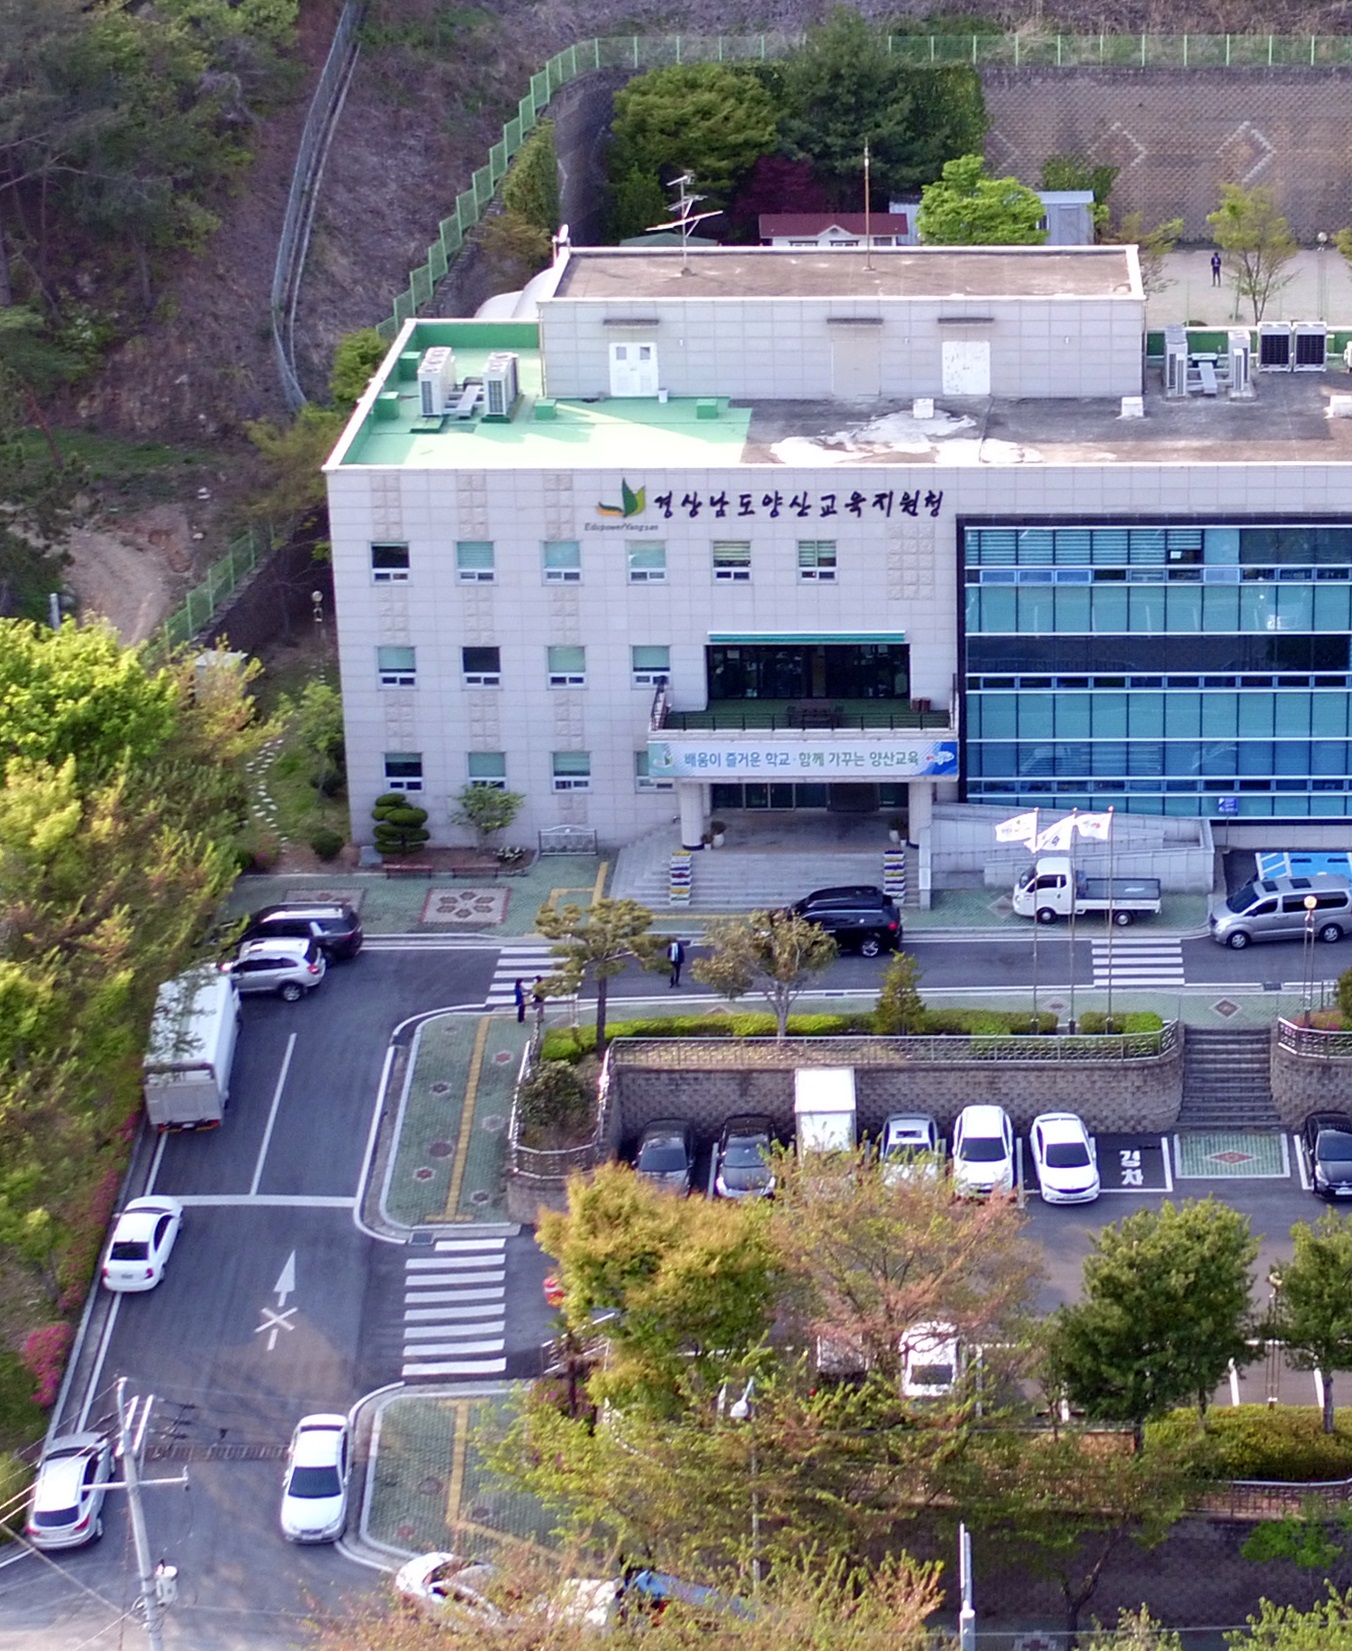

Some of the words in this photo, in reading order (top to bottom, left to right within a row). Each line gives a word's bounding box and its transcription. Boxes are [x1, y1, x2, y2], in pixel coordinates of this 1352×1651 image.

[654, 490, 944, 519] 경상남도양산교육지원청
[684, 751, 721, 768] 배움이
[725, 751, 761, 768] 즐거운
[799, 751, 825, 768] 함께
[828, 751, 865, 767] 가꾸는
[869, 750, 919, 767] 양산교육
[1119, 1150, 1144, 1186] 경차
